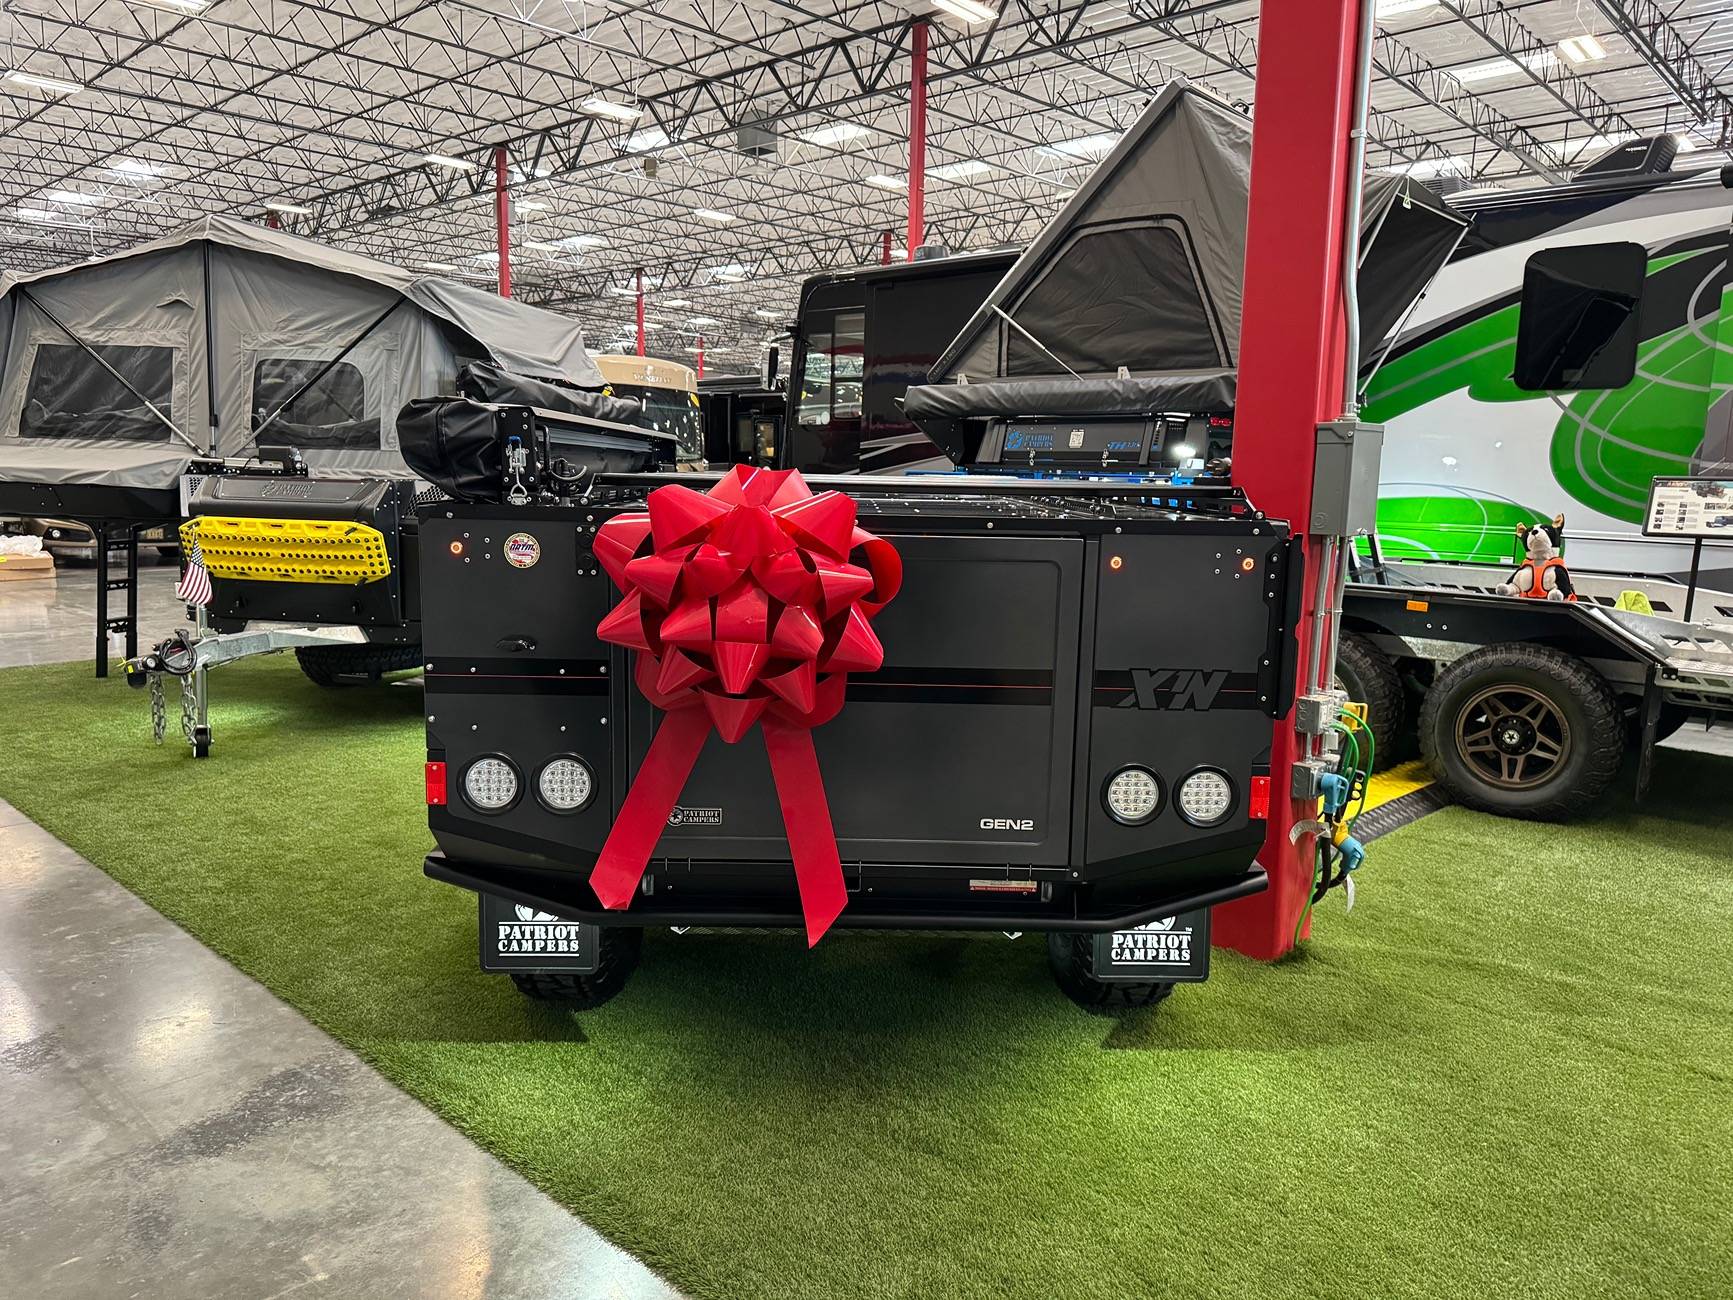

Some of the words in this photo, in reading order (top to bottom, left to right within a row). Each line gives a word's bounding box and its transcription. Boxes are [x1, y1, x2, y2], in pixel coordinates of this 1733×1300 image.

[980, 818, 1034, 831] GEN2
[498, 925, 579, 940] PATRIOT
[497, 939, 579, 952] CAMPERS
[1111, 934, 1192, 949] PATRIOT
[1110, 948, 1191, 961] CAMPERS
